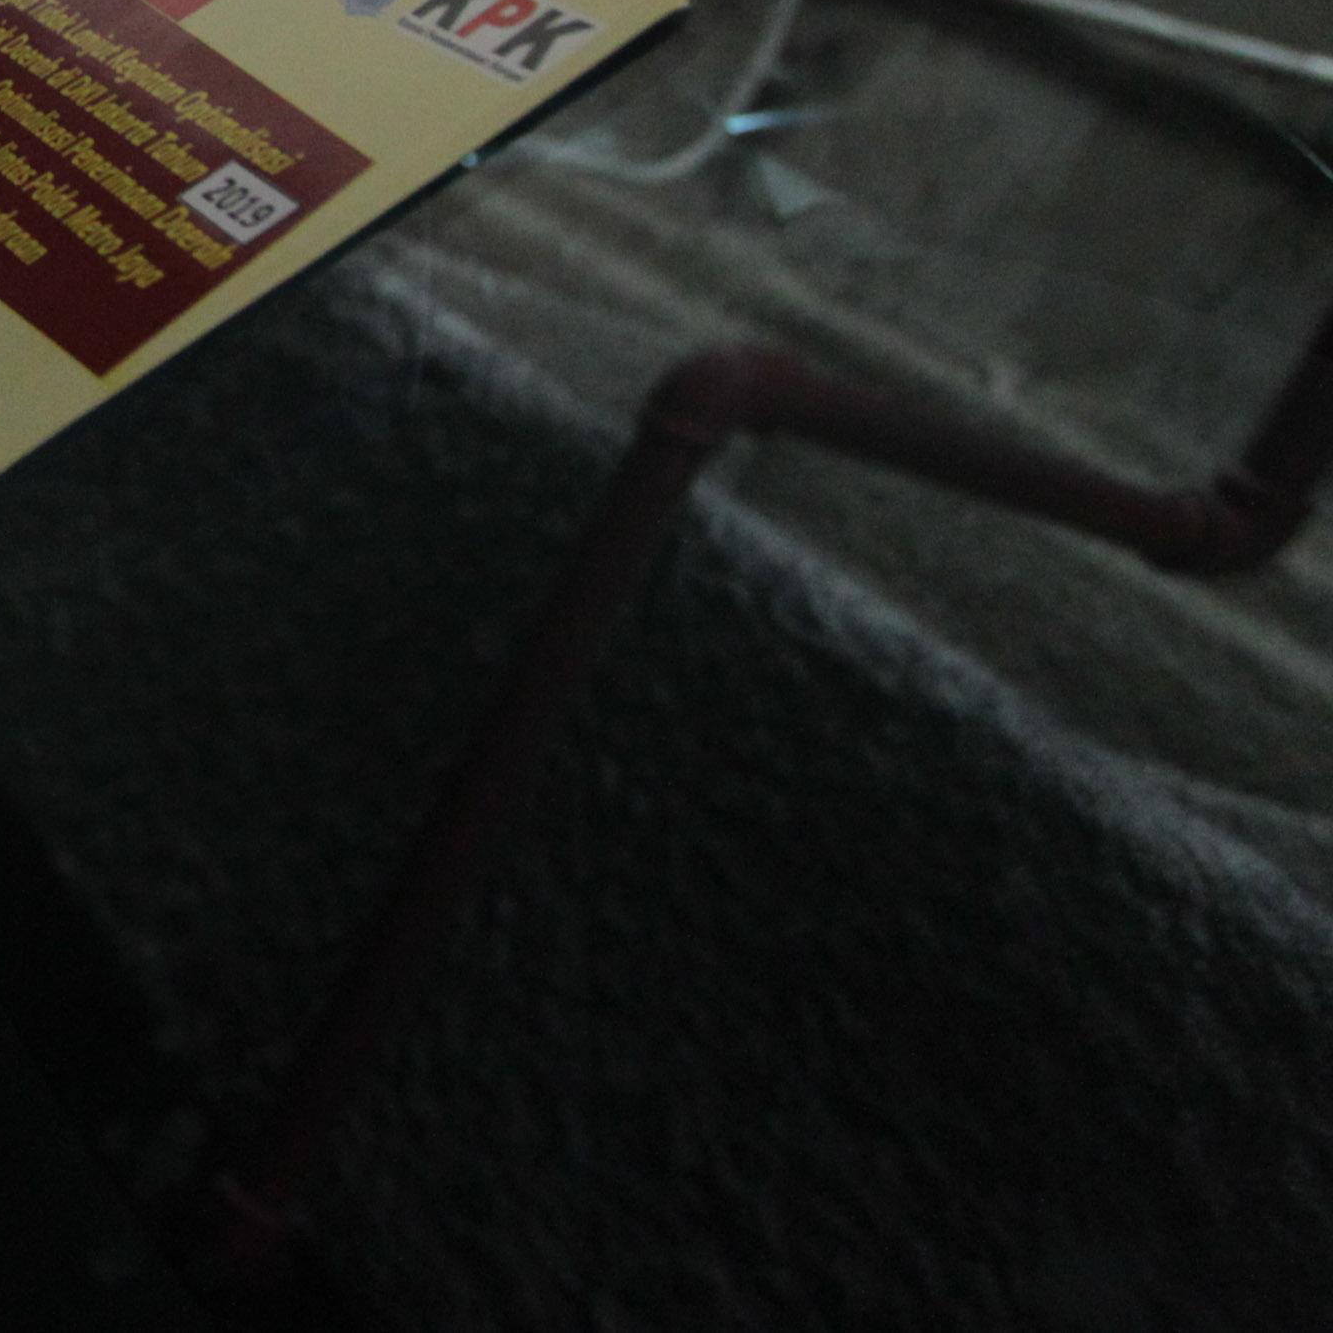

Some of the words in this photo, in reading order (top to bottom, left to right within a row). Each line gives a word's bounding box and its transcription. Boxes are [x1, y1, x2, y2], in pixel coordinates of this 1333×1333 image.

[0, 33, 63, 78] Daerah
[45, 66, 82, 89] di
[60, 74, 107, 106] DKI
[61, 19, 123, 62] Lanjut
[107, 47, 186, 103] Kegiatan
[174, 90, 301, 174] Optimalisasi
[85, 94, 157, 146] Jakarta
[144, 130, 209, 183] Tahun
[62, 137, 167, 219] Penerimaan
[152, 205, 234, 268] Daerah
[197, 173, 279, 233] 2019
[21, 171, 79, 218] Polda
[62, 204, 123, 256] Metro
[107, 243, 164, 288] Jaya
